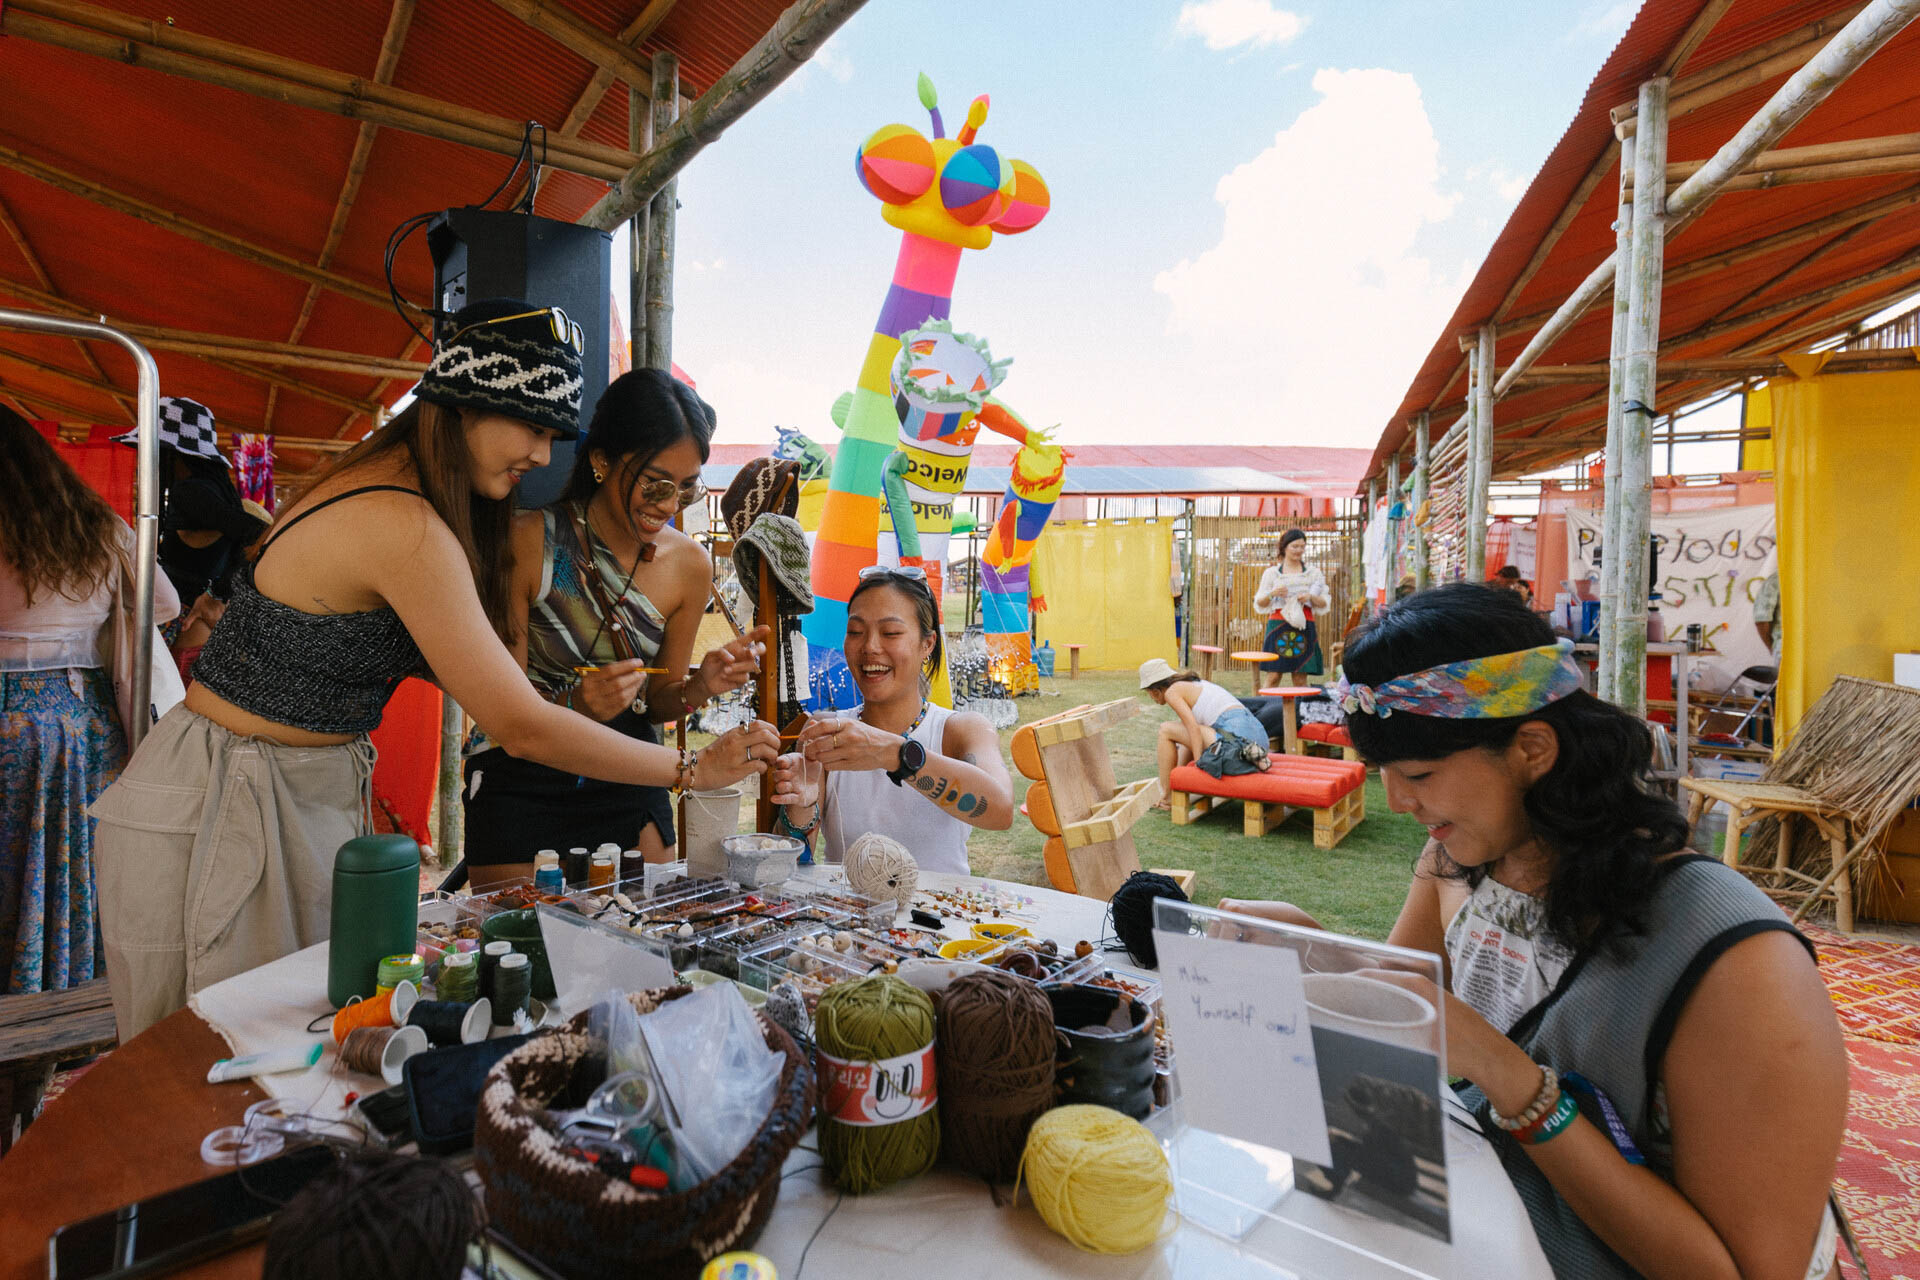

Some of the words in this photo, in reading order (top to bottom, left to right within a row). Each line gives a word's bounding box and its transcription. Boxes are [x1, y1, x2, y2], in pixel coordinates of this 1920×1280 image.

[908, 459, 968, 484] Welco
[1579, 528, 1776, 564] PCIOUS
[1543, 1105, 1571, 1132] FULL
